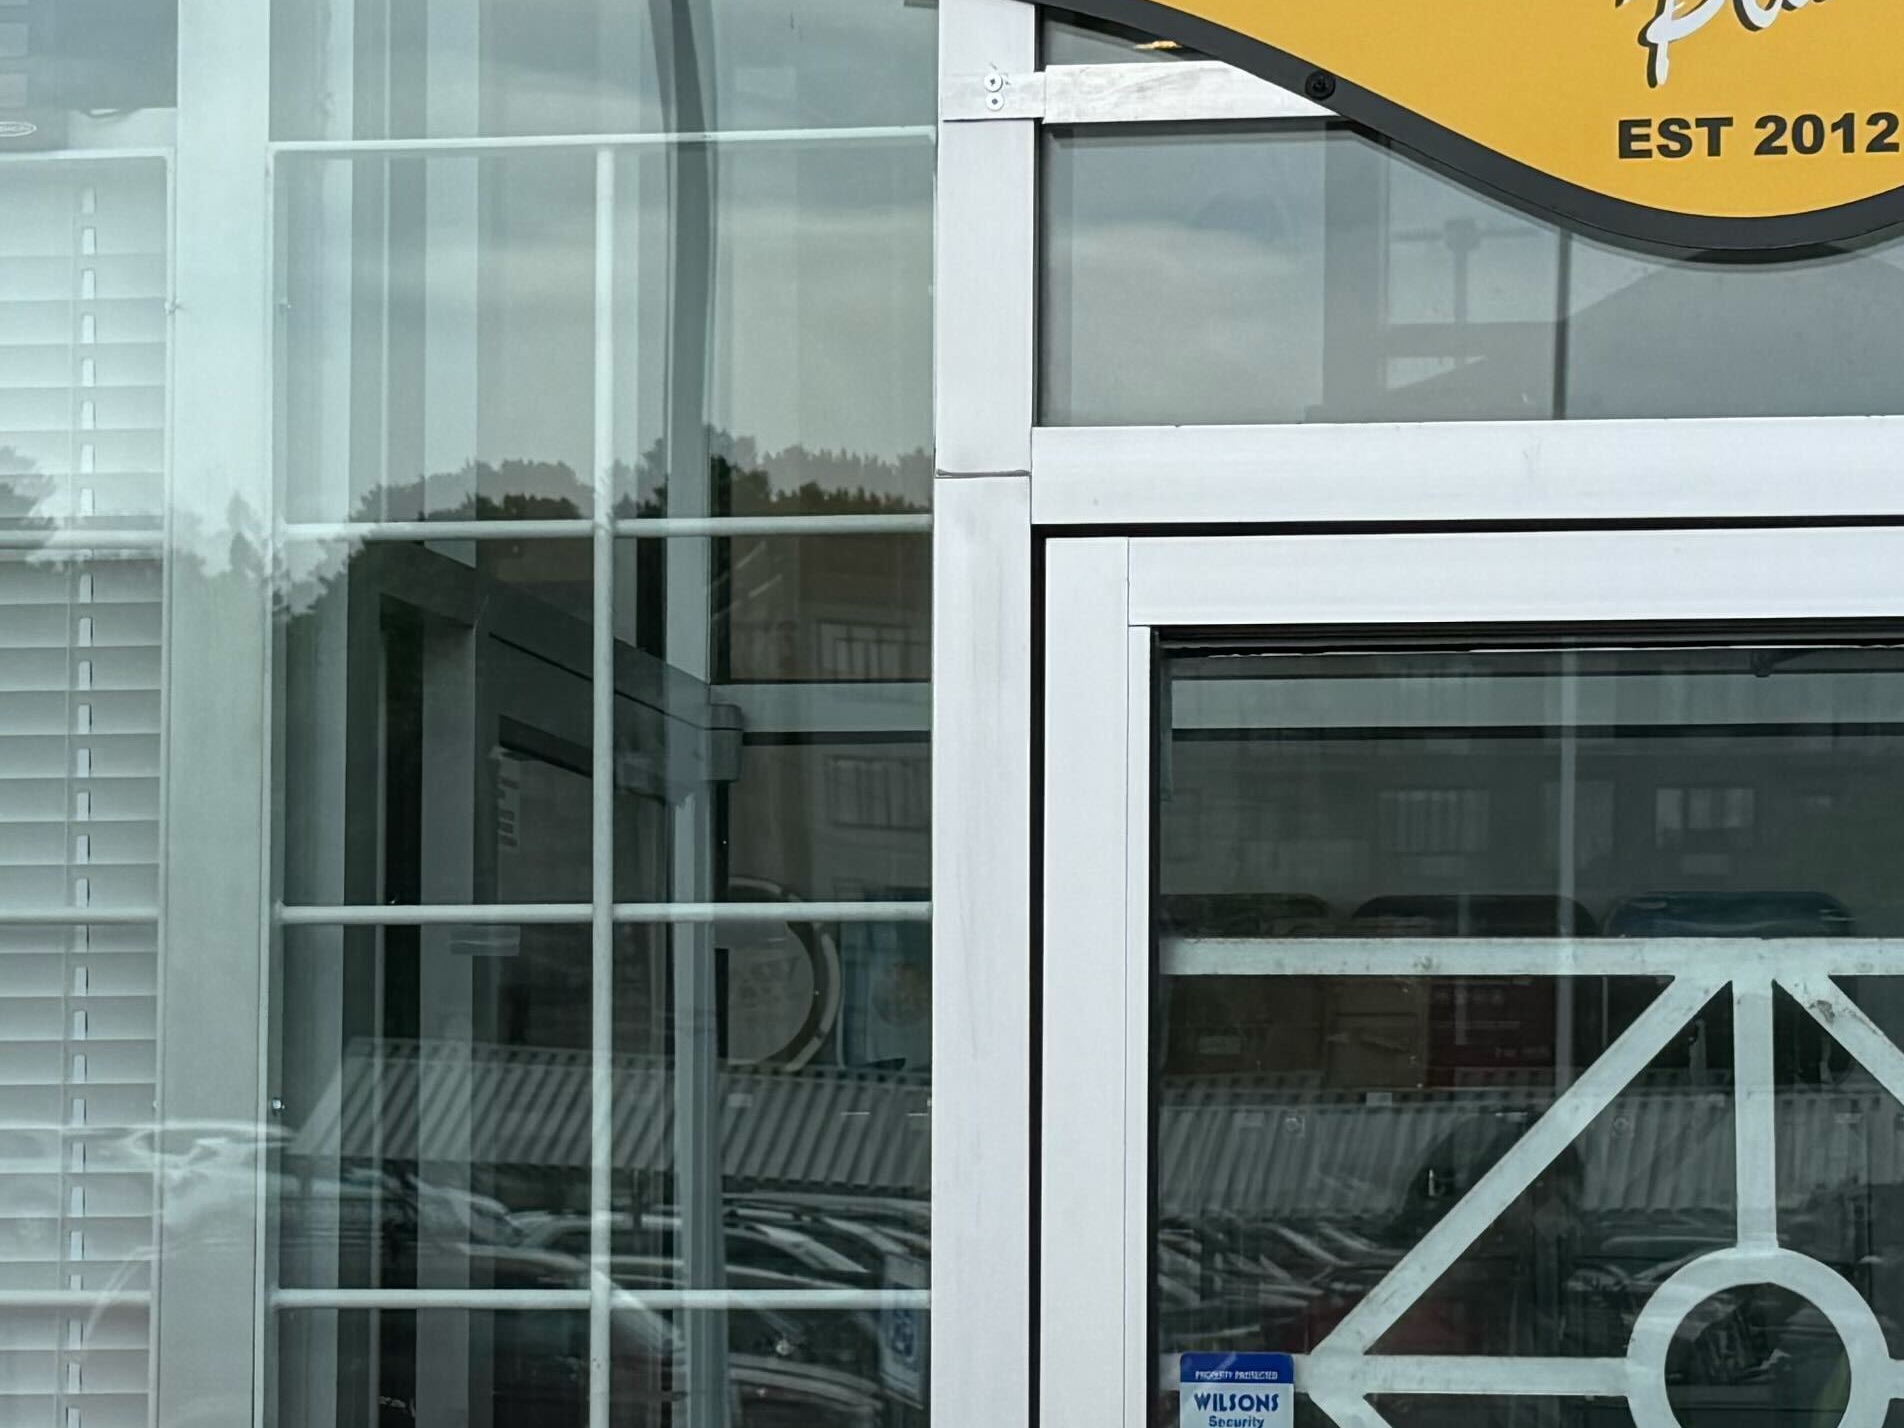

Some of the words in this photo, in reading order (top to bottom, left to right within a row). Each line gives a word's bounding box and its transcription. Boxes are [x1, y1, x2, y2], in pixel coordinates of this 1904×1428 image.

[1617, 117, 1733, 159] EST
[1752, 111, 1901, 155] 2012
[1194, 1392, 1279, 1413] WILSONS
